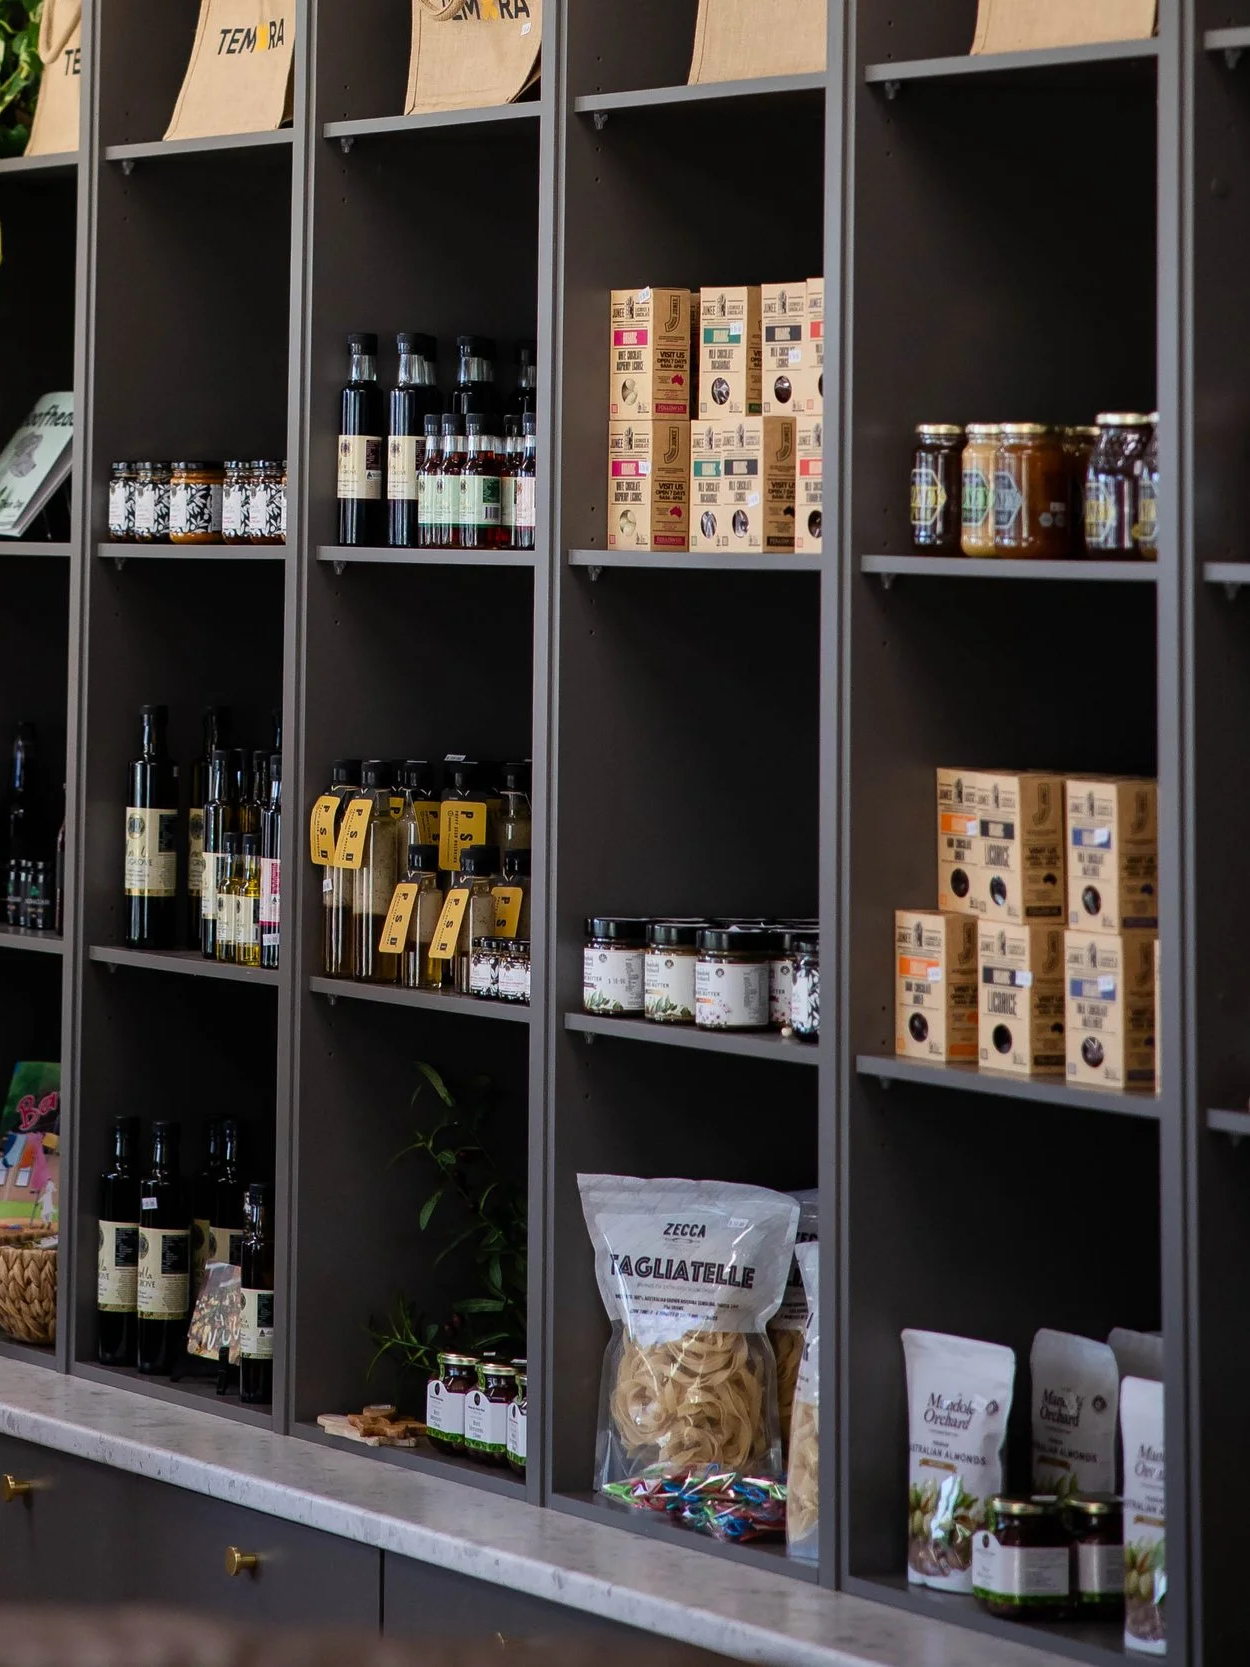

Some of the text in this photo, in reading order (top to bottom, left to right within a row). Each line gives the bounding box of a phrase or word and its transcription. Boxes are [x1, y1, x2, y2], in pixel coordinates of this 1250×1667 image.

[988, 989, 1017, 1016] LICORICE
[663, 1222, 707, 1238] ZECCA
[610, 1253, 756, 1290] TAGLIATELLE
[924, 1408, 973, 1430] Orchard
[944, 1451, 988, 1466] ALMONDS
